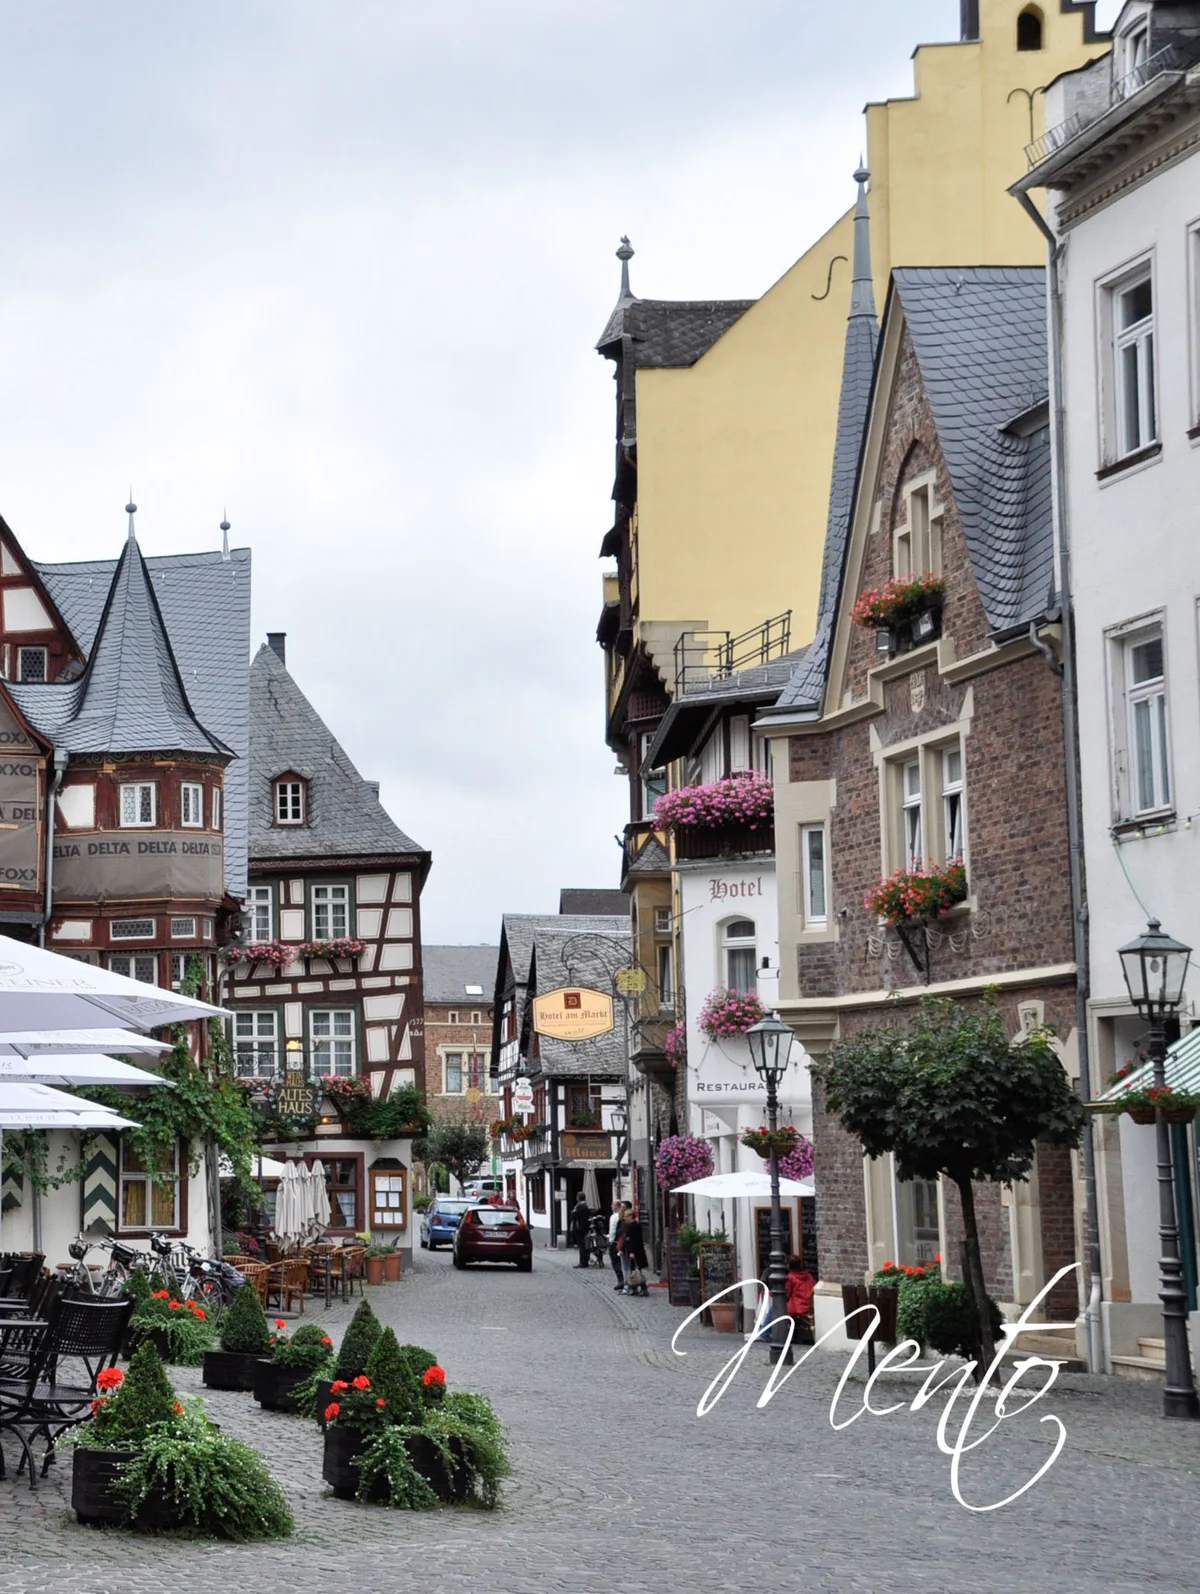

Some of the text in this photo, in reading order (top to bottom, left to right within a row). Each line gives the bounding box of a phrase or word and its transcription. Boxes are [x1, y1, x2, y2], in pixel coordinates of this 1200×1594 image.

[52, 844, 81, 858] ELTA
[87, 842, 131, 855] DELTA
[137, 841, 177, 854] DELTA
[182, 842, 209, 855] DELTA
[709, 876, 763, 903] Hotel
[539, 1012, 563, 1021] Hotel
[580, 1010, 608, 1019] Markt
[697, 1082, 781, 1092] RESTAURAT
[278, 1089, 313, 1101] ALTES
[278, 1102, 313, 1114] HAUS
